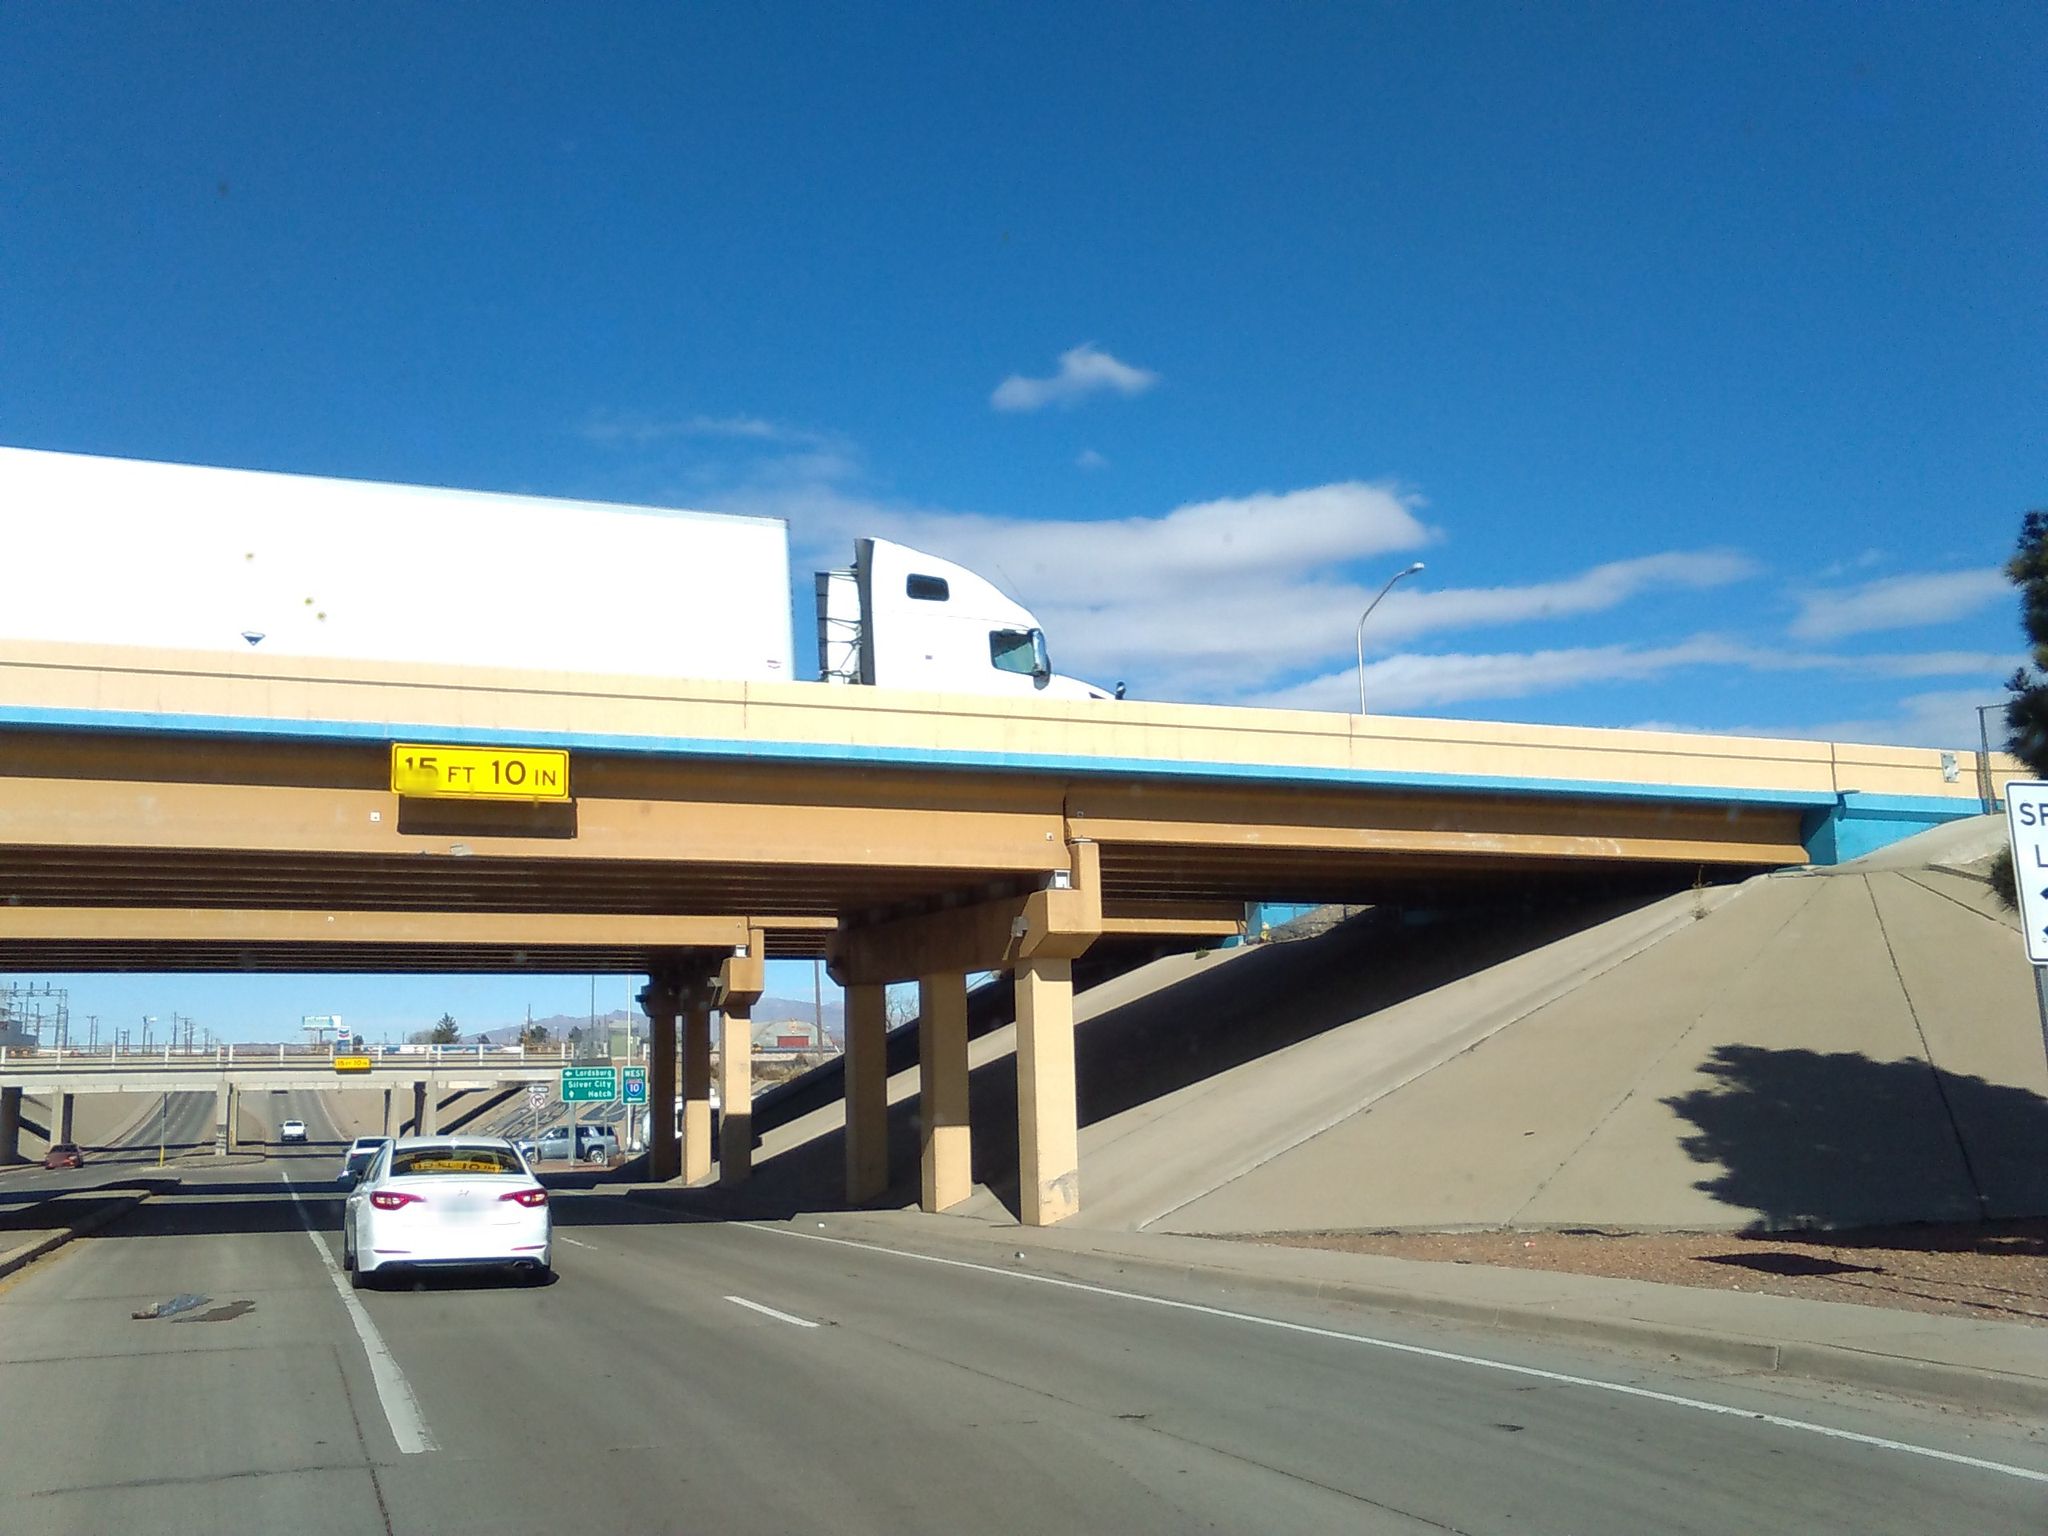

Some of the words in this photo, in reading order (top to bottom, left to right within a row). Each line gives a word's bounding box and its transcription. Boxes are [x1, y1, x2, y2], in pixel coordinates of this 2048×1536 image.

[448, 767, 475, 783] FT
[492, 760, 526, 785] 10
[535, 770, 556, 786] IN
[575, 1070, 612, 1078] Lordsburg
[594, 1081, 612, 1089] City
[629, 1083, 640, 1093] 10
[588, 1090, 612, 1098] Hatch
